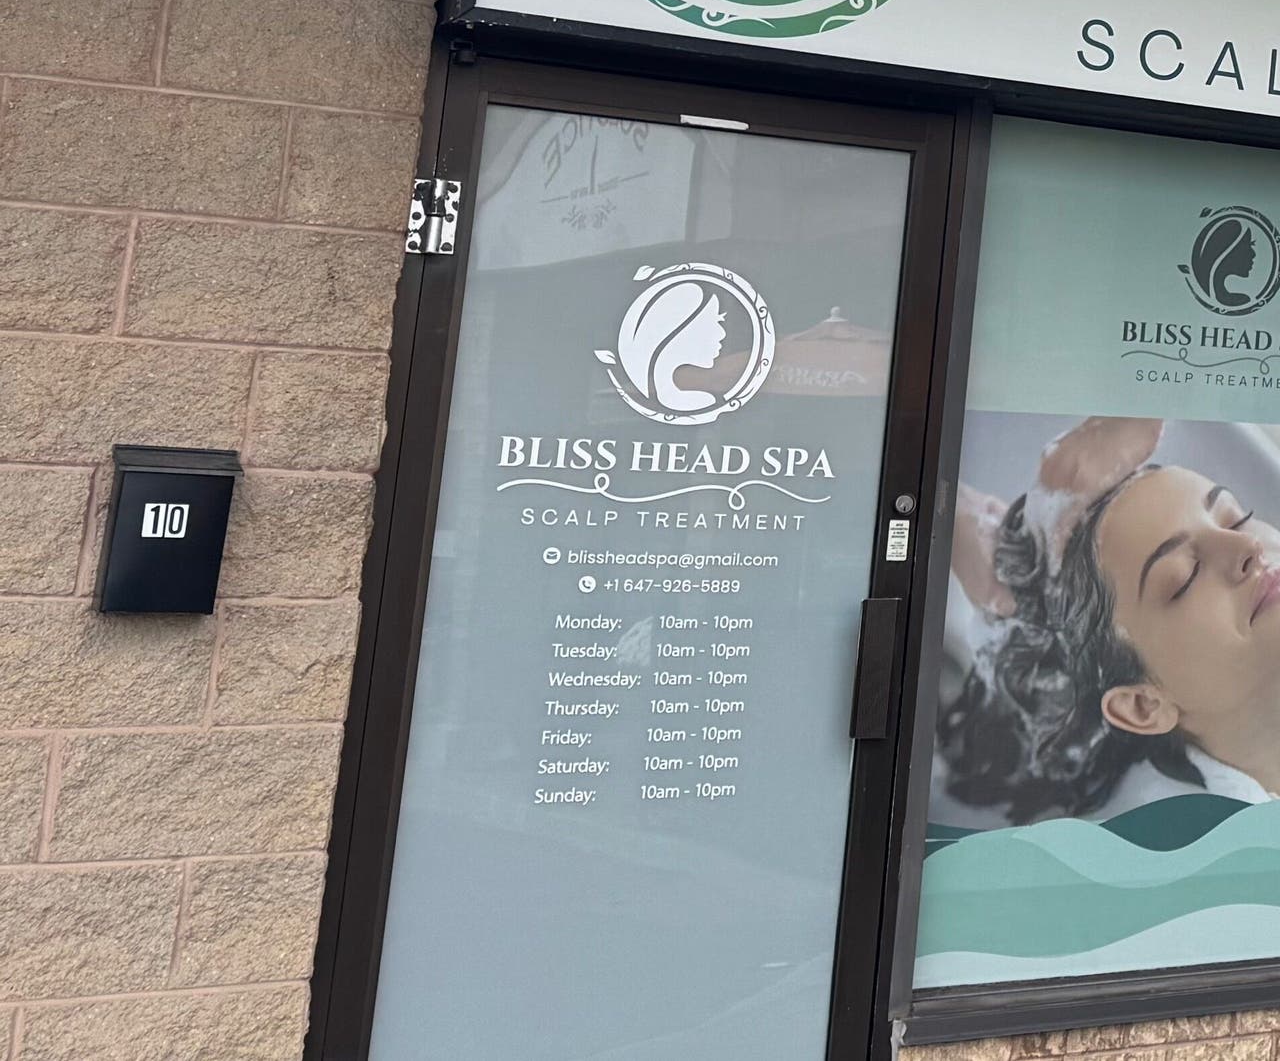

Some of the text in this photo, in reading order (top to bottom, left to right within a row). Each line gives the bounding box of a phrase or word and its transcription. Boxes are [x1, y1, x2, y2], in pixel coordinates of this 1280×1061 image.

[1122, 321, 1192, 346] BLISS
[1200, 326, 1272, 351] HEAD
[1135, 370, 1194, 383] SCALP
[497, 436, 835, 478] BLISS HEAD SPA
[150, 505, 185, 535] 10
[521, 508, 805, 531] SCALP TREATMENT
[568, 550, 778, 569] blissheadspa@gmail.com
[623, 579, 741, 593] 647-926-5889
[555, 614, 622, 632] Monday:
[659, 616, 698, 629] 10am
[713, 616, 753, 632] 10pm
[552, 643, 617, 660] Tuesday:
[656, 644, 695, 657] 10am
[710, 644, 750, 659] 10pm
[548, 672, 641, 689] Wednesday:
[653, 672, 692, 685] 10am
[707, 671, 747, 687] 10pm
[545, 701, 619, 718] Thursday:
[650, 700, 689, 713] 10am
[704, 699, 744, 715] 10pm
[541, 730, 592, 747] Friday:
[647, 728, 686, 741] 10am
[701, 727, 741, 743] 10pm
[538, 758, 610, 775] Saturday:
[643, 756, 683, 770] 10am
[698, 755, 738, 771] 10pm
[534, 787, 596, 805] Sunday:
[640, 785, 680, 798] 10am
[695, 783, 735, 800] 10pm
